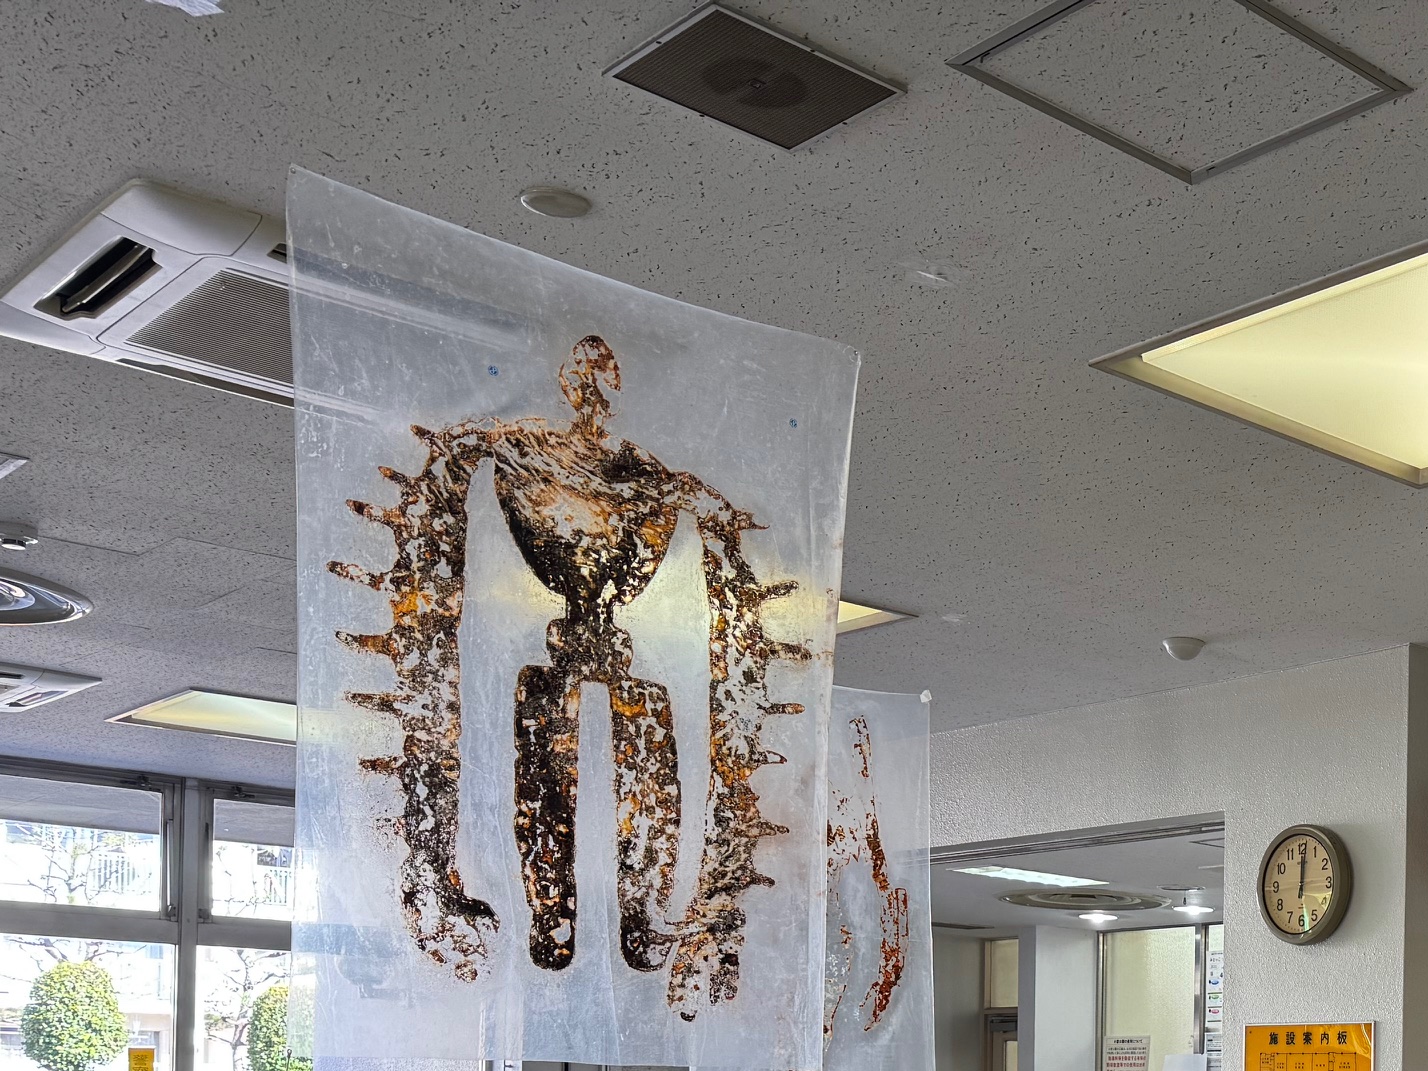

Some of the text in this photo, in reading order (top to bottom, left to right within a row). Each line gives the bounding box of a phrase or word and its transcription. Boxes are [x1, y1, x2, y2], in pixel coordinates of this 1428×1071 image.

[1286, 845, 1317, 861] 11 1
[1298, 842, 1307, 855] 12
[1277, 858, 1329, 875] 10 2
[1272, 876, 1332, 893] 9 3
[1276, 896, 1327, 911] 8 4
[1287, 909, 1318, 927] 7 6 5
[1269, 1031, 1348, 1046] 施設案内板
